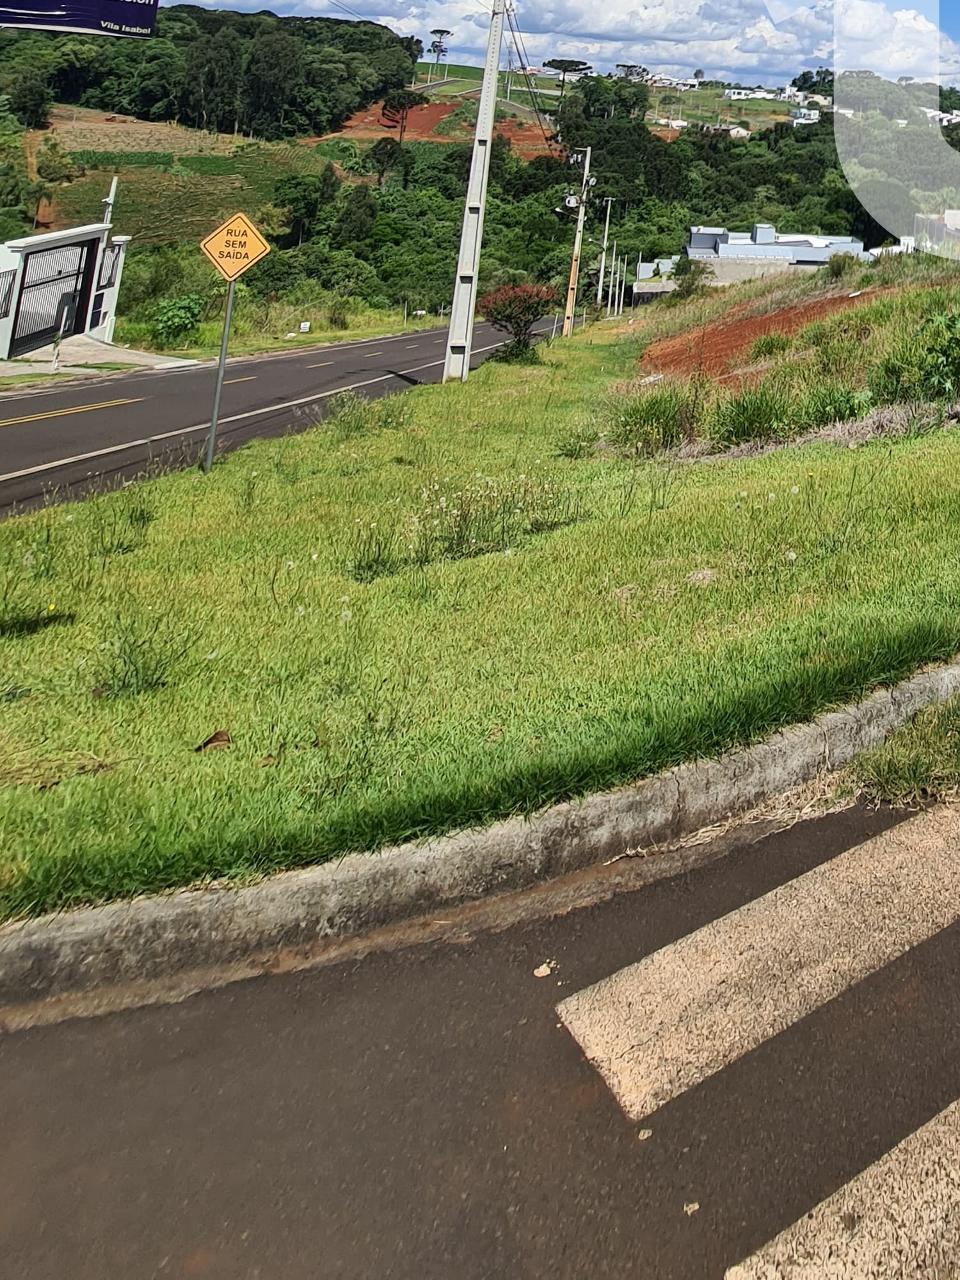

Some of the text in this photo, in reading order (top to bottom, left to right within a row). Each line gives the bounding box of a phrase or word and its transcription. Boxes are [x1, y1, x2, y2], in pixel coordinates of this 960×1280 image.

[100, 20, 151, 34] Vila Isabel
[226, 228, 248, 238] RUA
[224, 240, 247, 249] SEM
[218, 249, 249, 260] SAÍDA
